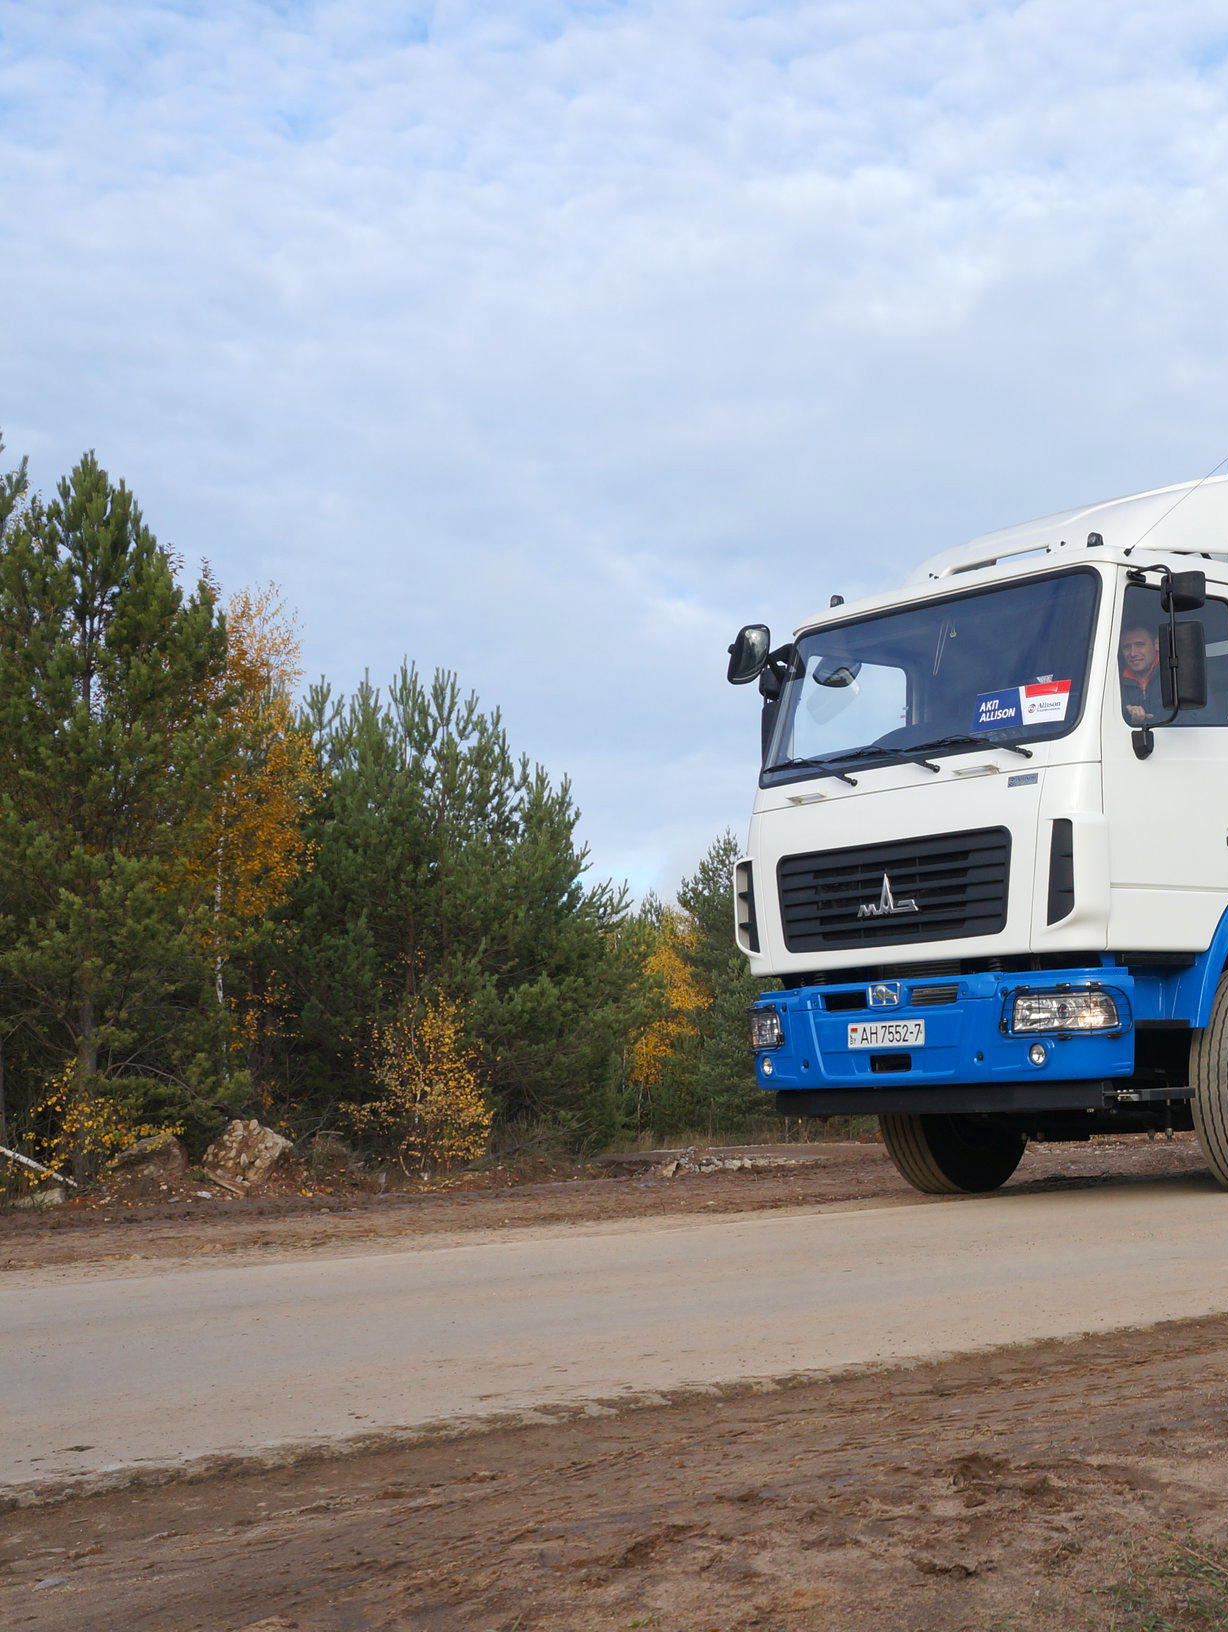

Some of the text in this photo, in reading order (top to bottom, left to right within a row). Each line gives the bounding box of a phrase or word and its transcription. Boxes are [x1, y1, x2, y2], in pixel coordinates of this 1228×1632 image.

[979, 700, 999, 712] АКП
[979, 708, 1015, 722] ALLISON
[881, 1023, 921, 1043] 7552-7
